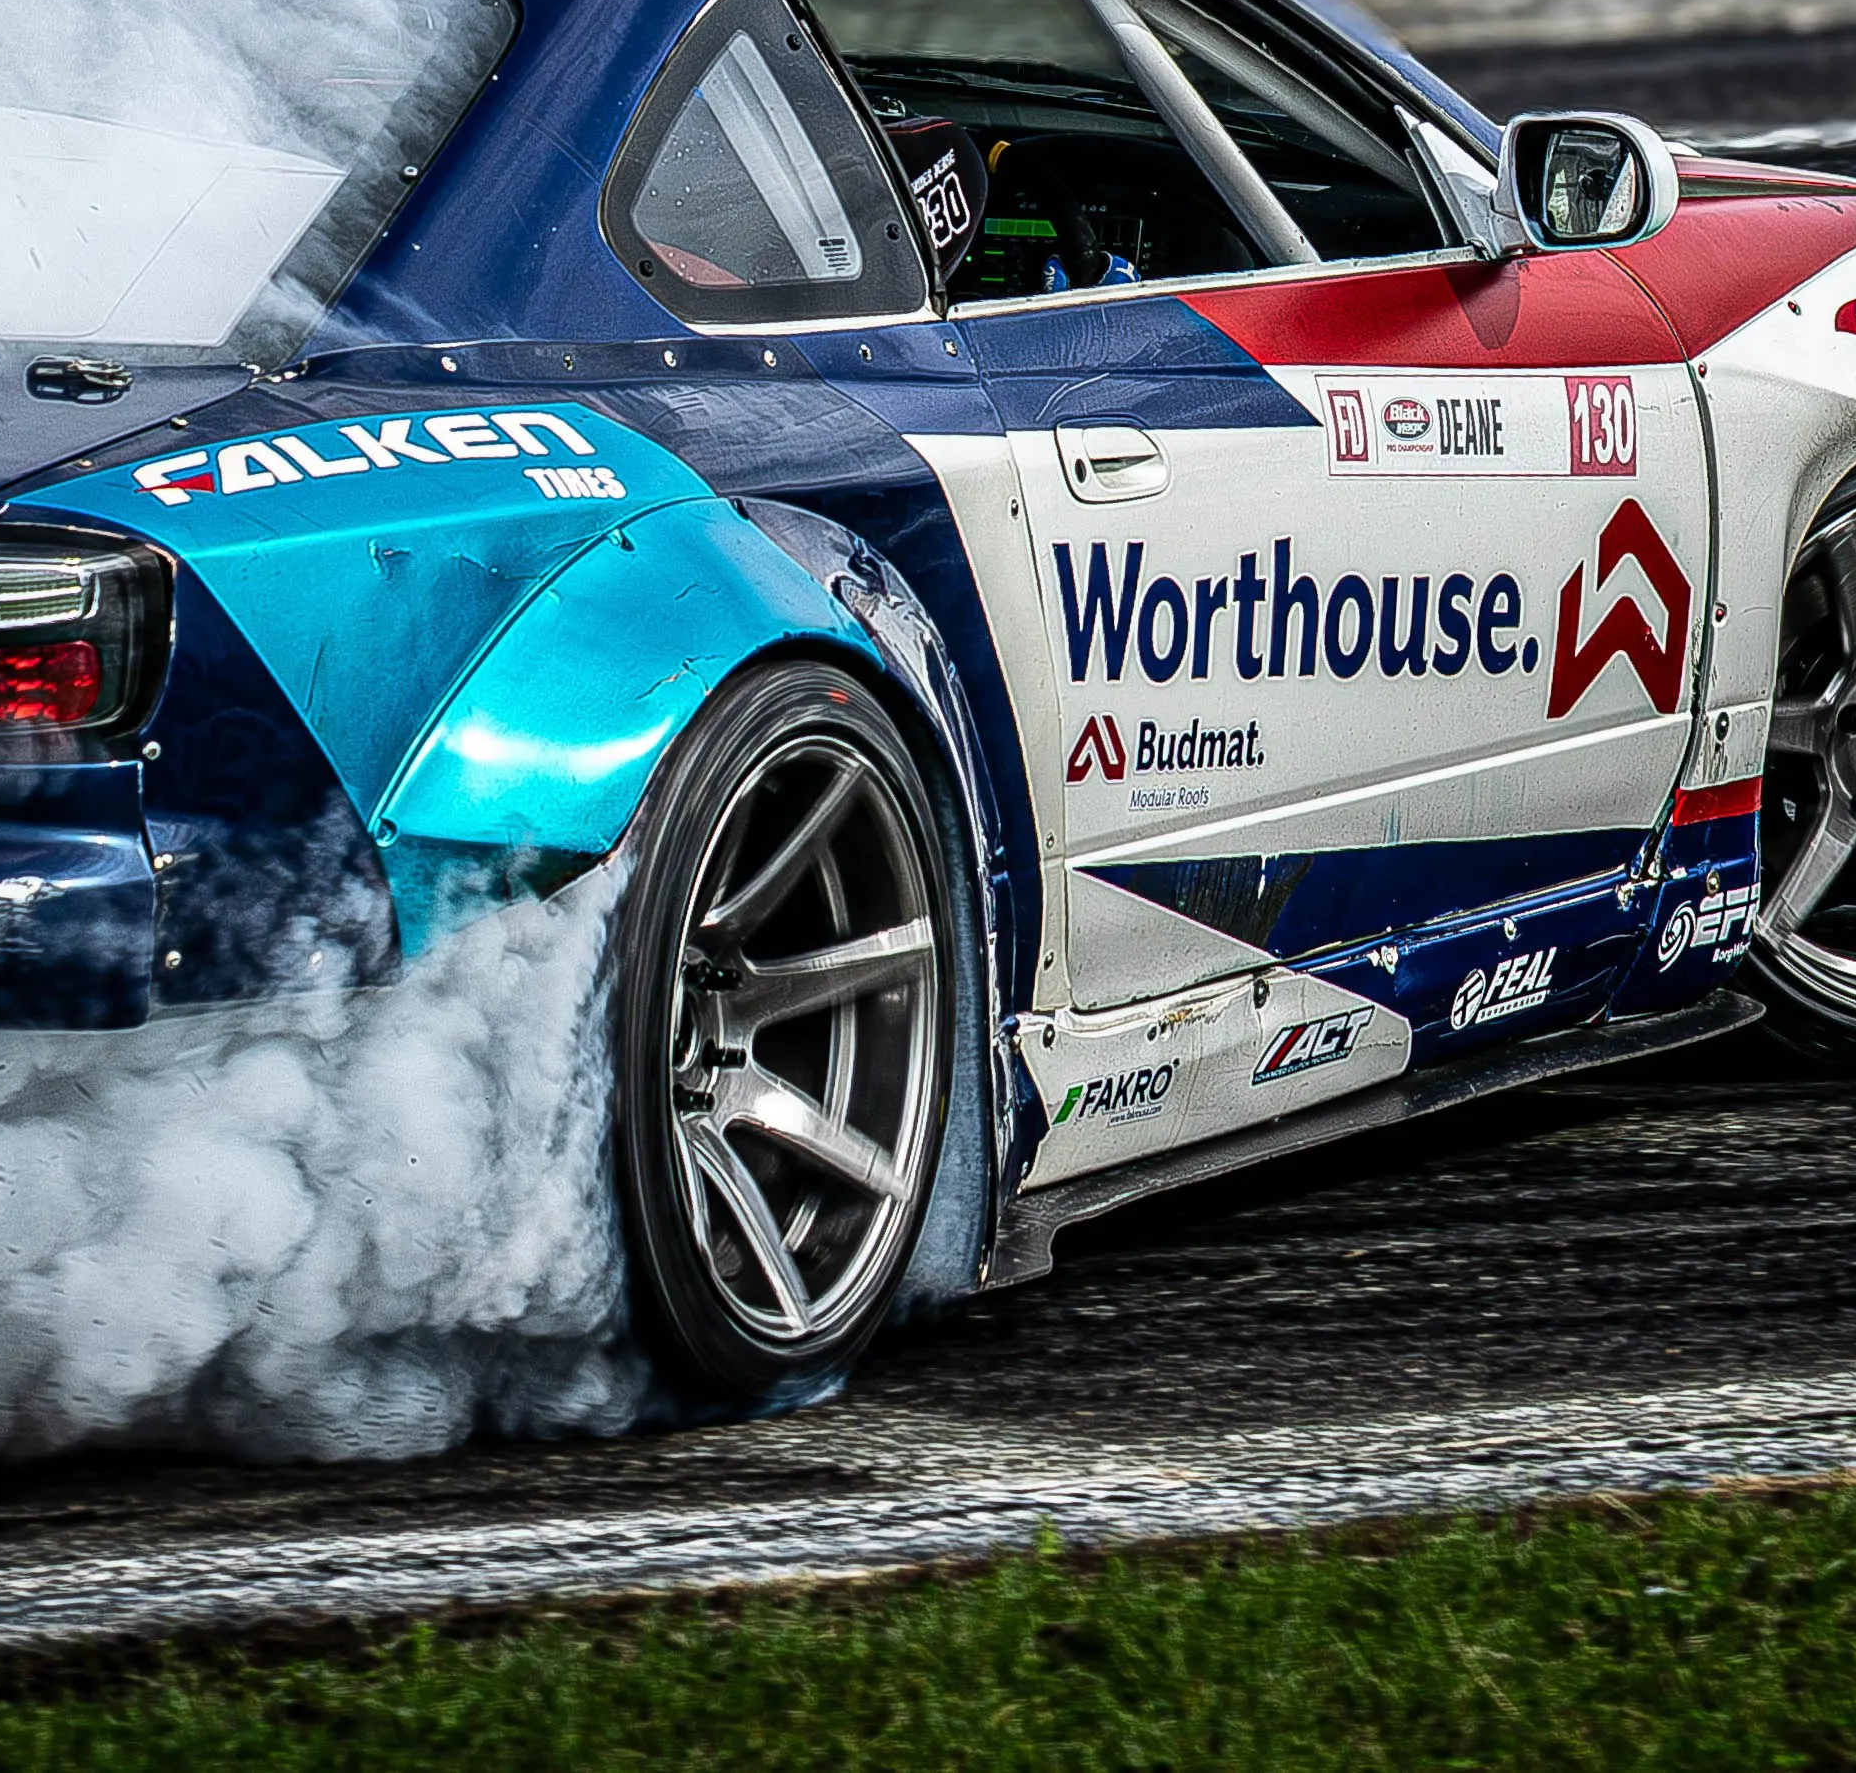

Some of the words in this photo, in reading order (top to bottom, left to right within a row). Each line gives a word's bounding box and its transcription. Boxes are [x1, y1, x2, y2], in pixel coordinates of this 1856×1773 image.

[1389, 403, 1429, 422] Black
[1436, 399, 1504, 456] DEANE
[1573, 383, 1636, 465] 130
[131, 412, 598, 508] FALKEN
[522, 466, 628, 500] TIRES
[1051, 536, 1540, 685] Worthouse.
[1135, 718, 1265, 772] Budmat.
[1130, 788, 1176, 807] Modular
[1177, 786, 1210, 806] Roofs
[1483, 946, 1557, 1004] FEAL
[1279, 1008, 1373, 1066] ACT
[1079, 1064, 1173, 1118] FAKRO
